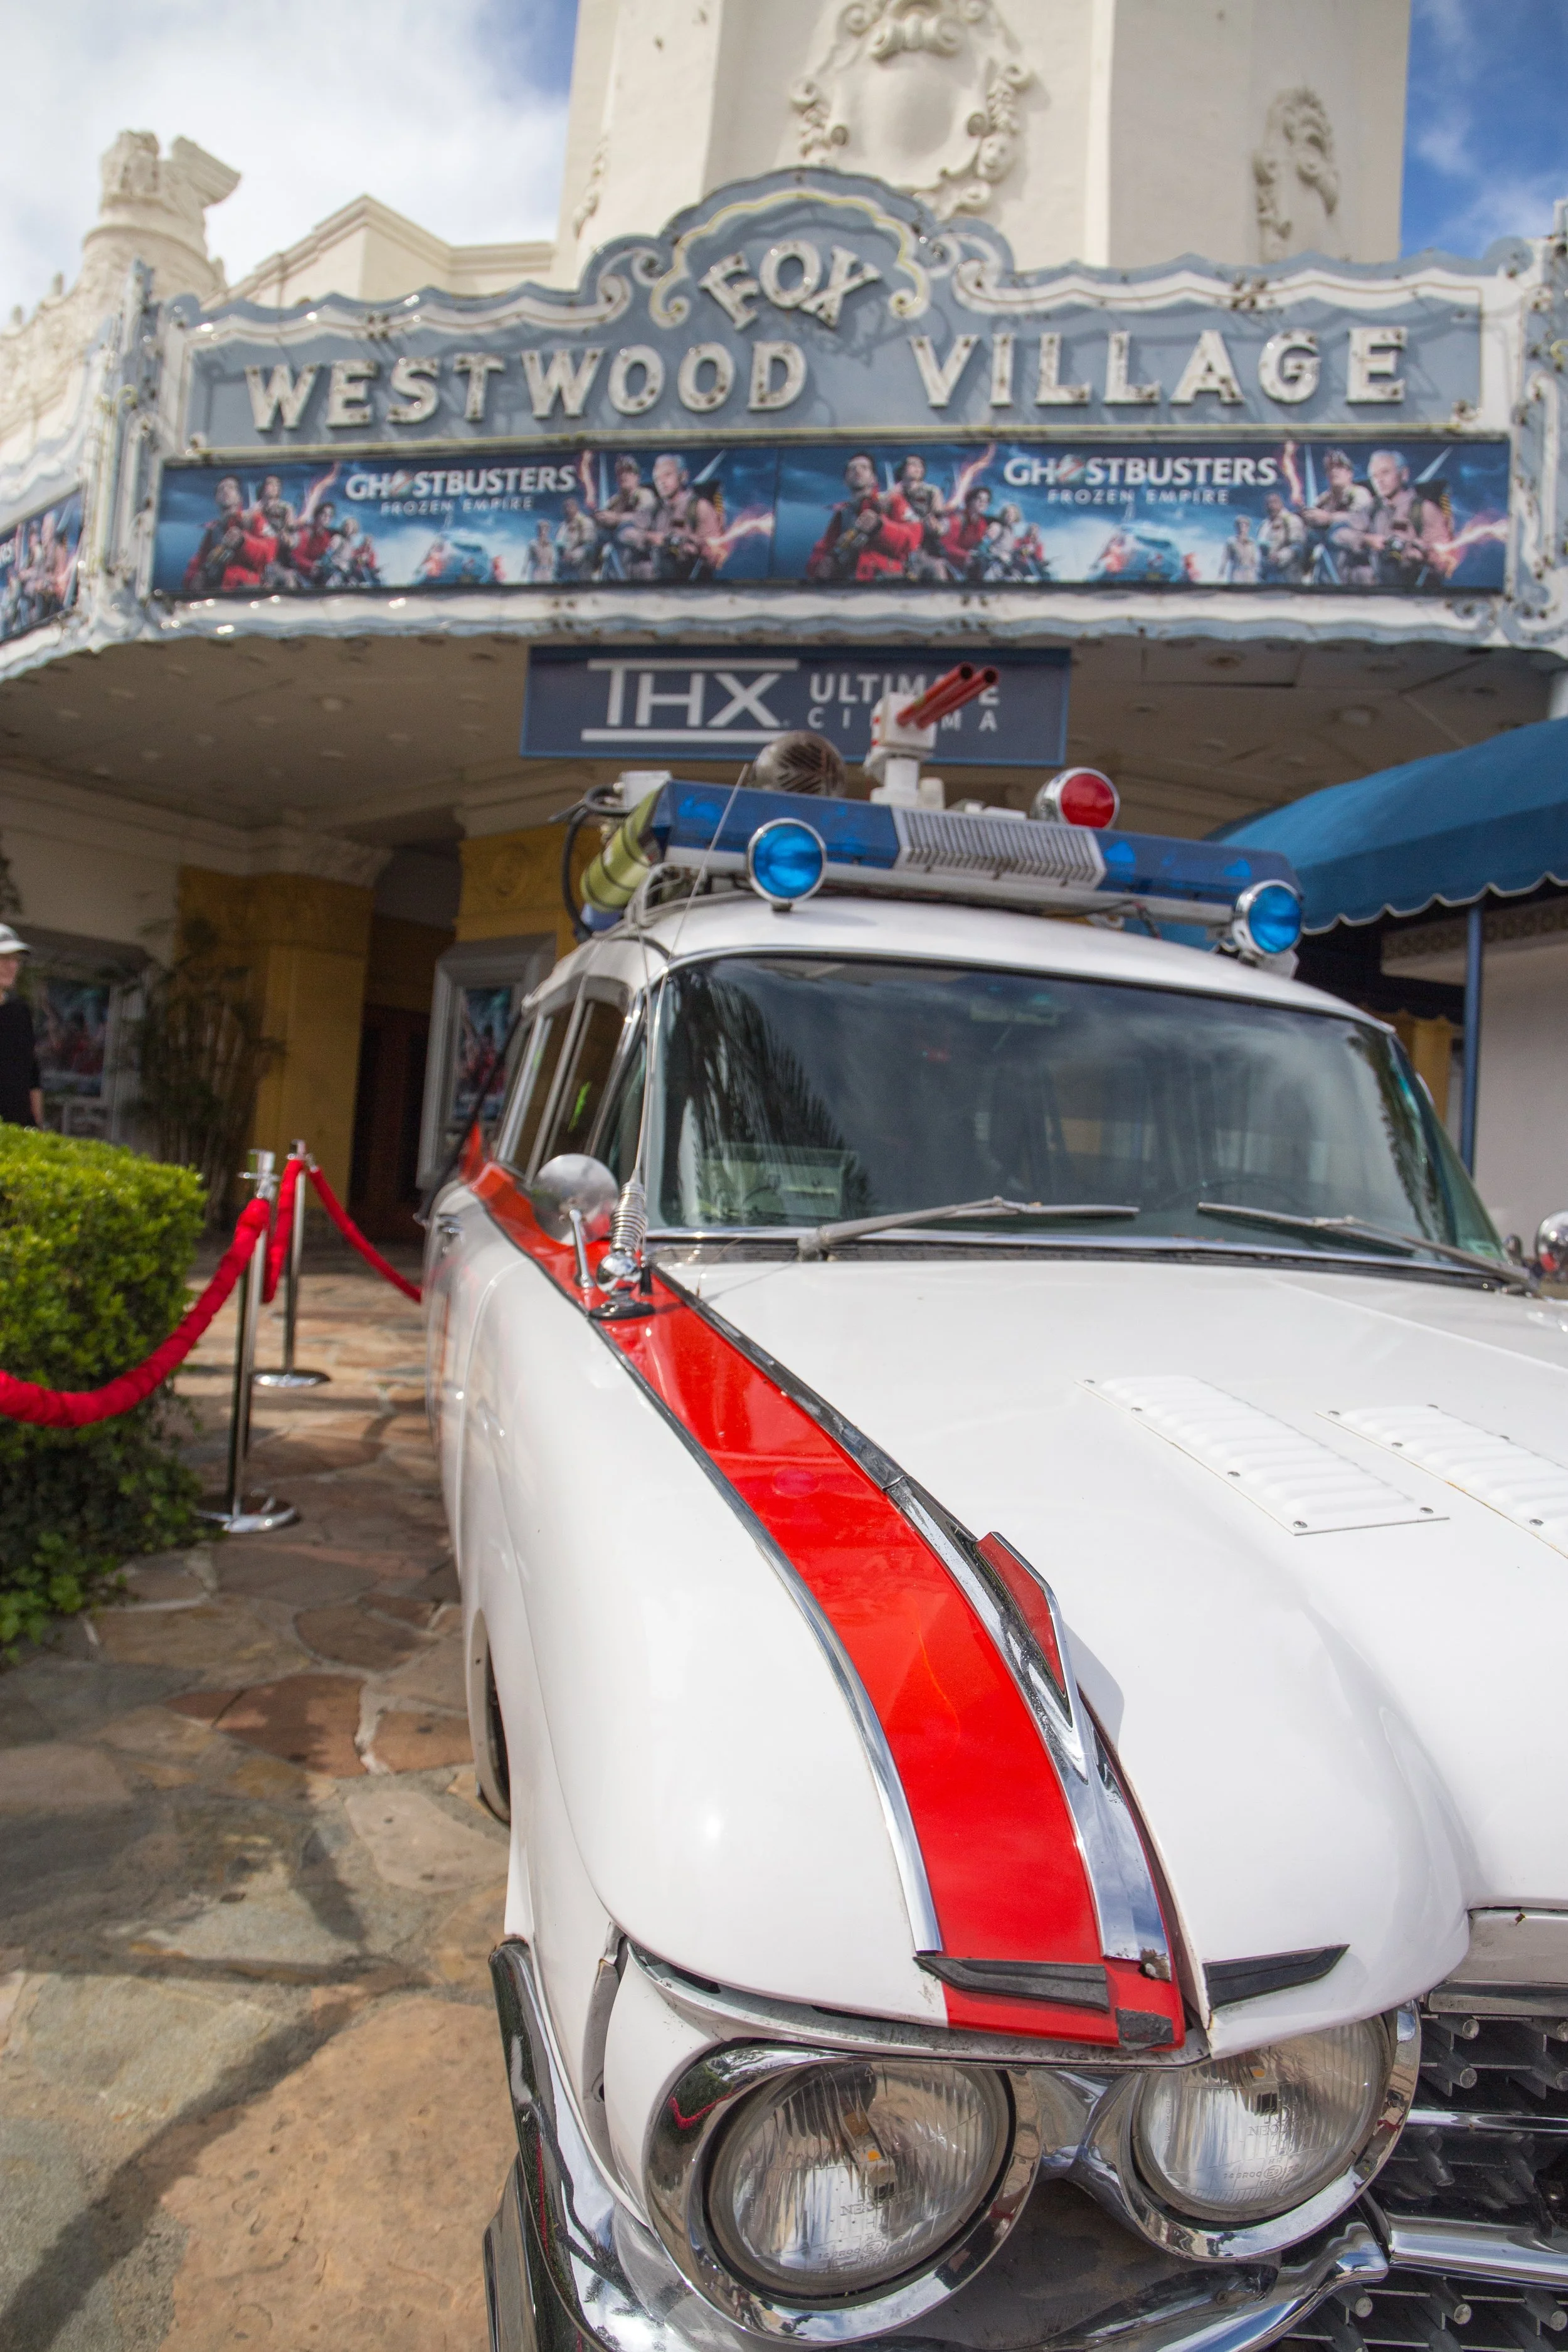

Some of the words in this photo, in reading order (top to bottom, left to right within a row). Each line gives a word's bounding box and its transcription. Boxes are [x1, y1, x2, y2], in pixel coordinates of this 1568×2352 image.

[697, 239, 881, 331] FOX
[245, 341, 807, 432] WESTWOOD
[910, 327, 1409, 408] VILLAGE
[381, 499, 454, 516] FROZEN
[463, 496, 534, 512] EMPIRE
[1047, 489, 1135, 505] FROZEN
[1146, 489, 1230, 505] EMPIRE
[587, 659, 799, 728] THX
[807, 706, 998, 733] CIMA
